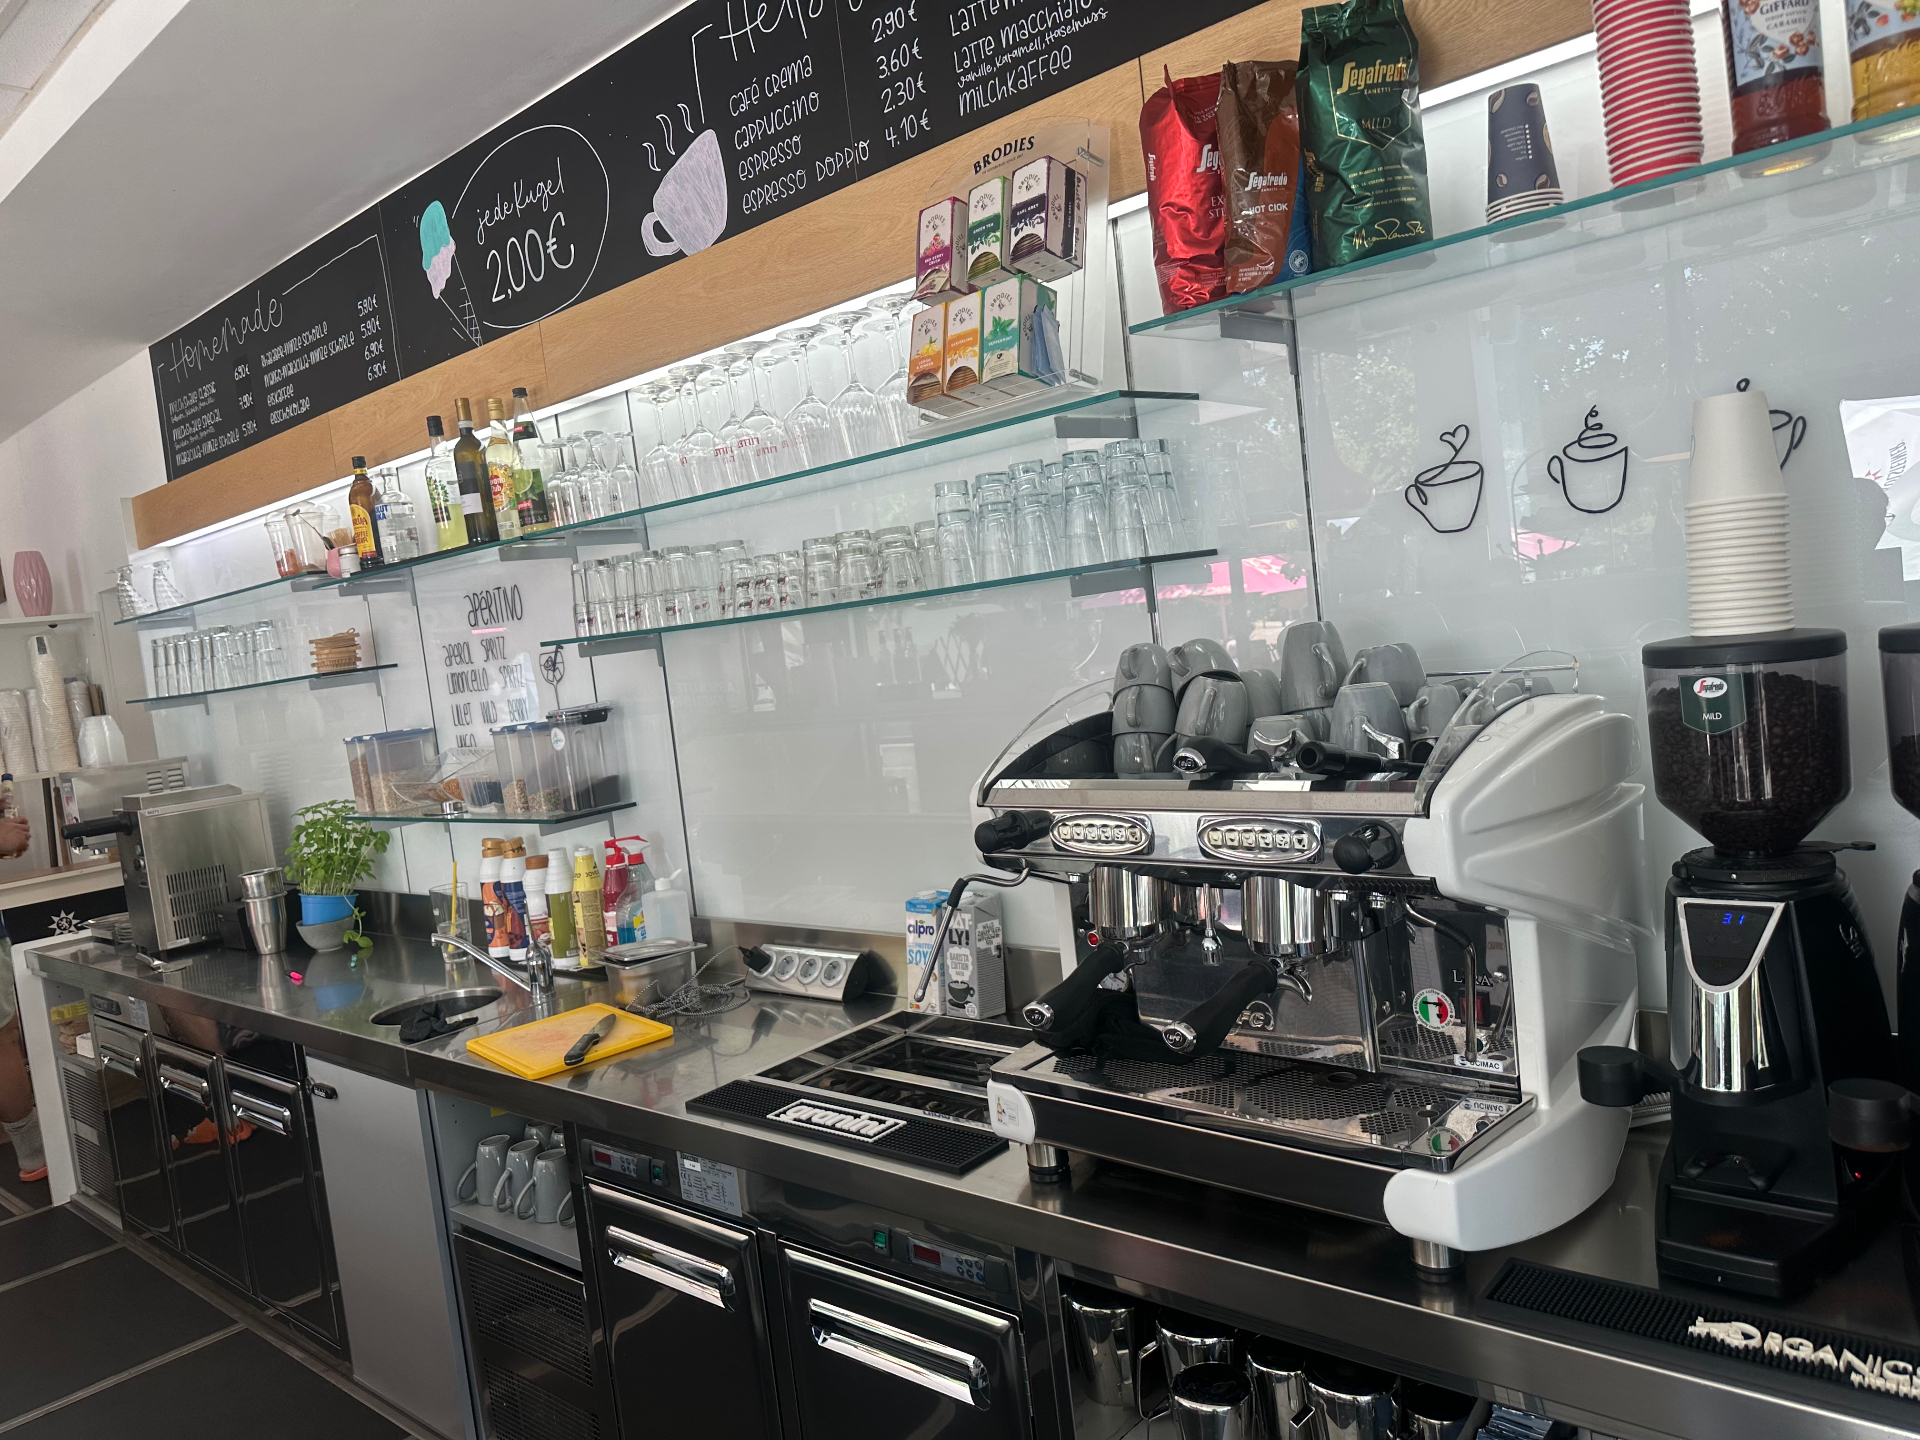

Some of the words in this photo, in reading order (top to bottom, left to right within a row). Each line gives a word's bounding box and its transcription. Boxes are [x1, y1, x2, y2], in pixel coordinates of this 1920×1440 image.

[1767, 18, 1806, 30] CARAMEL
[1364, 87, 1391, 95] ZANETTI
[1361, 117, 1392, 130] MILD
[973, 135, 1035, 175] BRODIES
[512, 156, 565, 218] Kugel
[1018, 173, 1041, 191] BRODIES
[1244, 171, 1288, 192] Segafredo
[974, 193, 996, 209] BRODIES
[1249, 204, 1266, 215] HOT
[1268, 203, 1289, 212] CIOK
[925, 214, 946, 229] BRODIES
[486, 211, 575, 303] 2,00€
[991, 292, 1013, 308] BRODIES
[953, 306, 974, 322] BRODIES
[918, 318, 938, 333] BRODIES
[988, 335, 1013, 346] PEPPERMINT
[1702, 712, 1723, 721] MILD
[907, 919, 935, 938] alpro
[948, 928, 970, 946] LY!
[949, 952, 970, 963] BARISTA
[950, 961, 969, 972] EDITION
[1440, 994, 1454, 1014] machine
[780, 1104, 890, 1136] granini
[1722, 1320, 1920, 1386] ORGANIC
